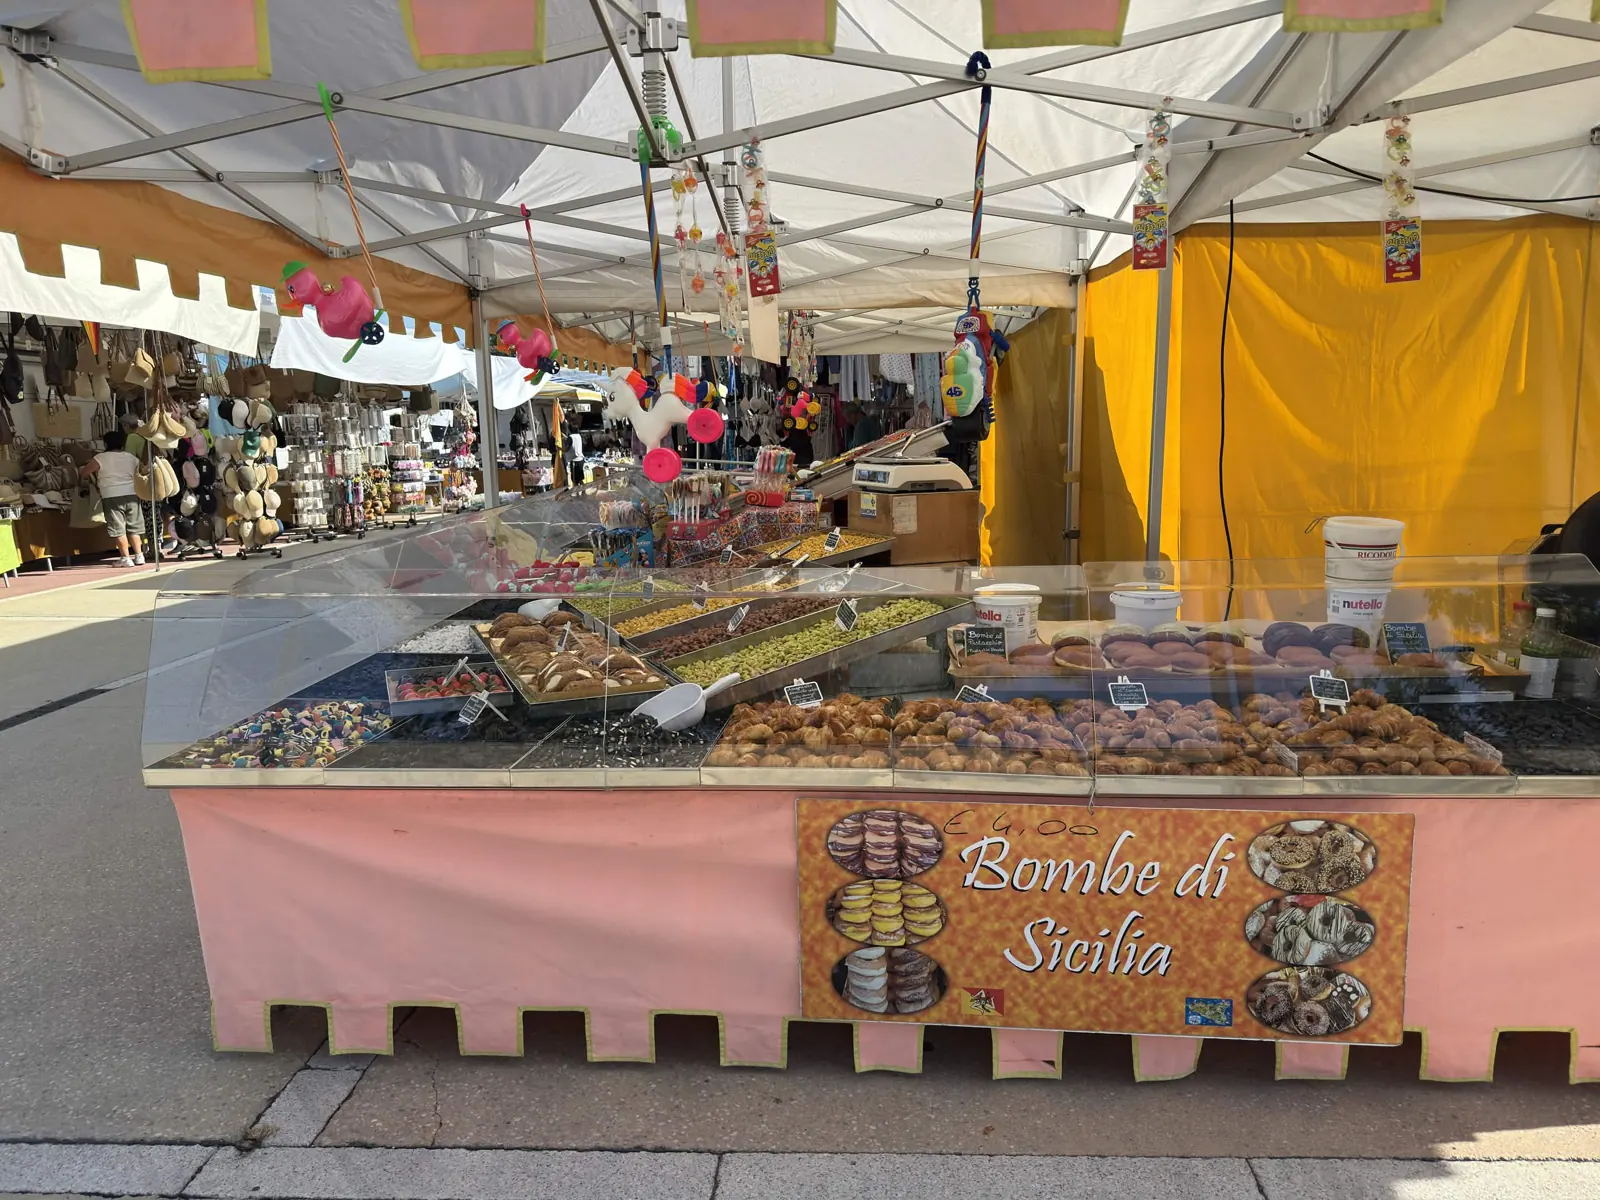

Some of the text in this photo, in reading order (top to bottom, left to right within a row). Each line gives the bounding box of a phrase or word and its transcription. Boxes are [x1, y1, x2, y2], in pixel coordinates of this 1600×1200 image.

[945, 386, 963, 398] 46
[1342, 599, 1383, 610] nutella
[1384, 623, 1416, 632] Bombe
[968, 630, 993, 638] Bombe
[959, 830, 1236, 899] Bombe di
[1003, 910, 1173, 976] Sicilia
